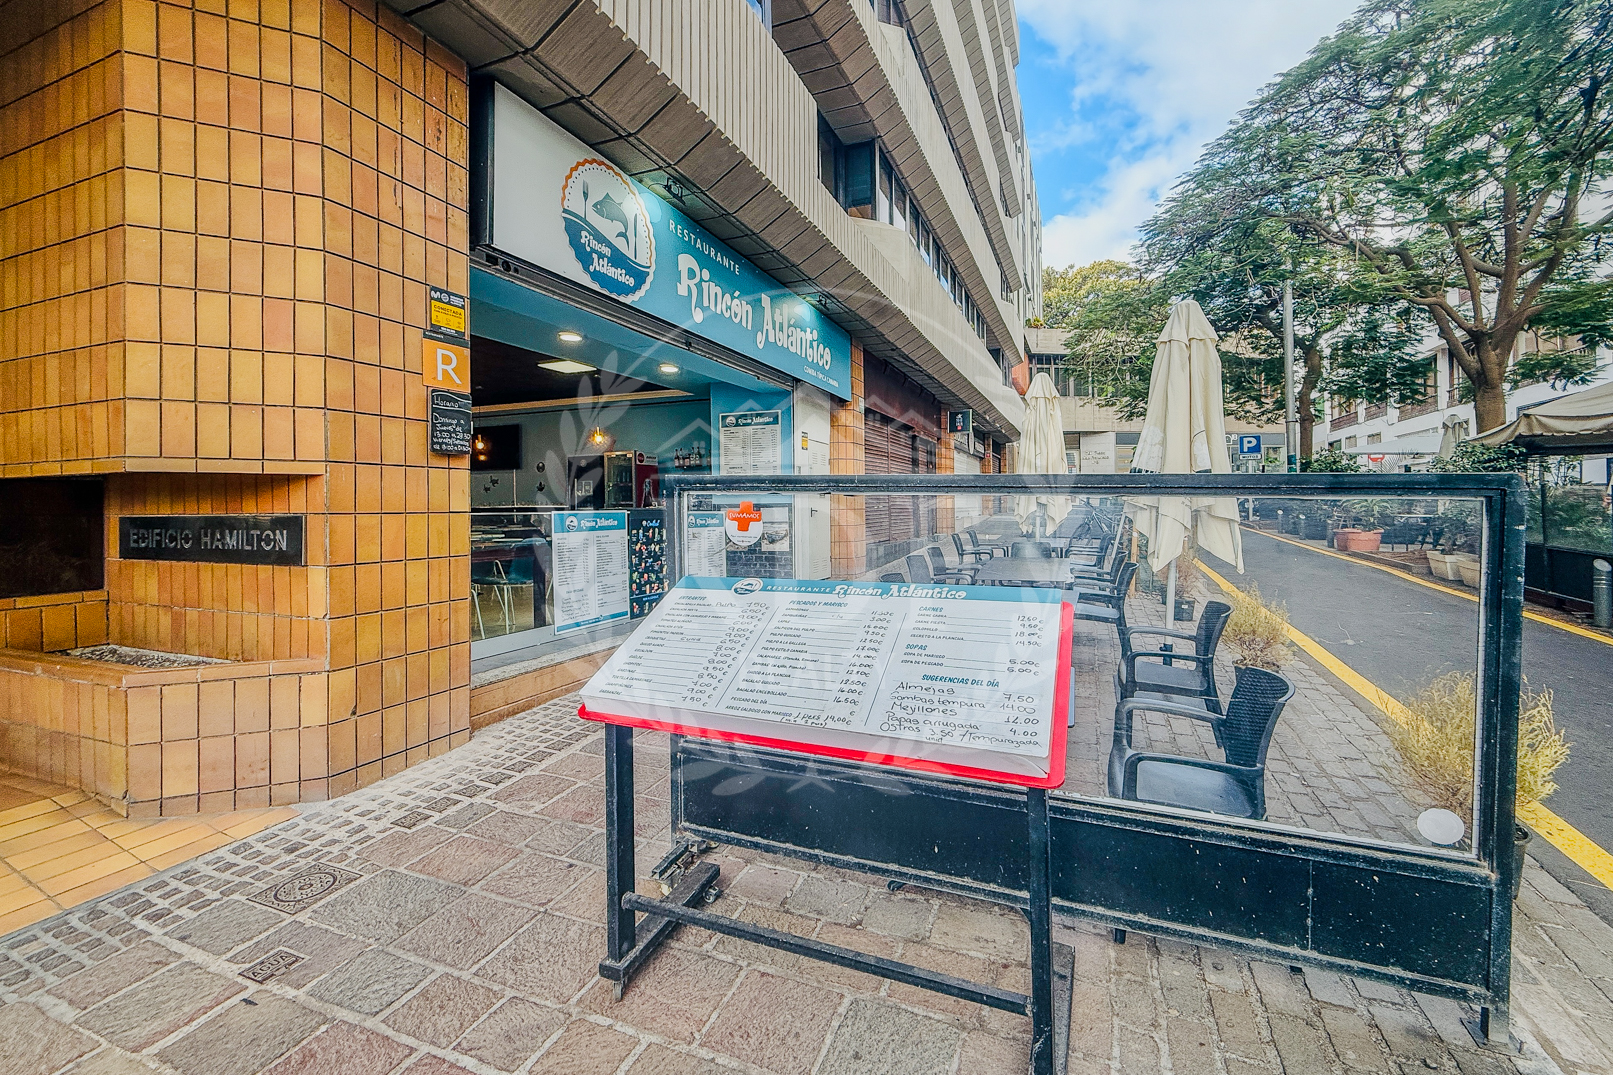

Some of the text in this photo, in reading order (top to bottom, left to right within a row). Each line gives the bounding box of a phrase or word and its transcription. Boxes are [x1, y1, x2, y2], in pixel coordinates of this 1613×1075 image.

[581, 231, 611, 257] Rincón
[669, 219, 740, 276] RESTAURANTE
[589, 253, 635, 287] Atlántico
[677, 253, 831, 370] Rincón Atlántico
[436, 348, 462, 384] R
[1243, 437, 1257, 453] P
[130, 529, 287, 551] EDIFICIO HAMILTON
[766, 585, 831, 594] RESTAURANTE
[832, 584, 883, 598] Rincón
[882, 584, 967, 600] Atlántico
[905, 643, 928, 651] SOPAS
[895, 682, 955, 697] Almejas
[921, 674, 1000, 688] SUGERENCIAS DEL DÍA
